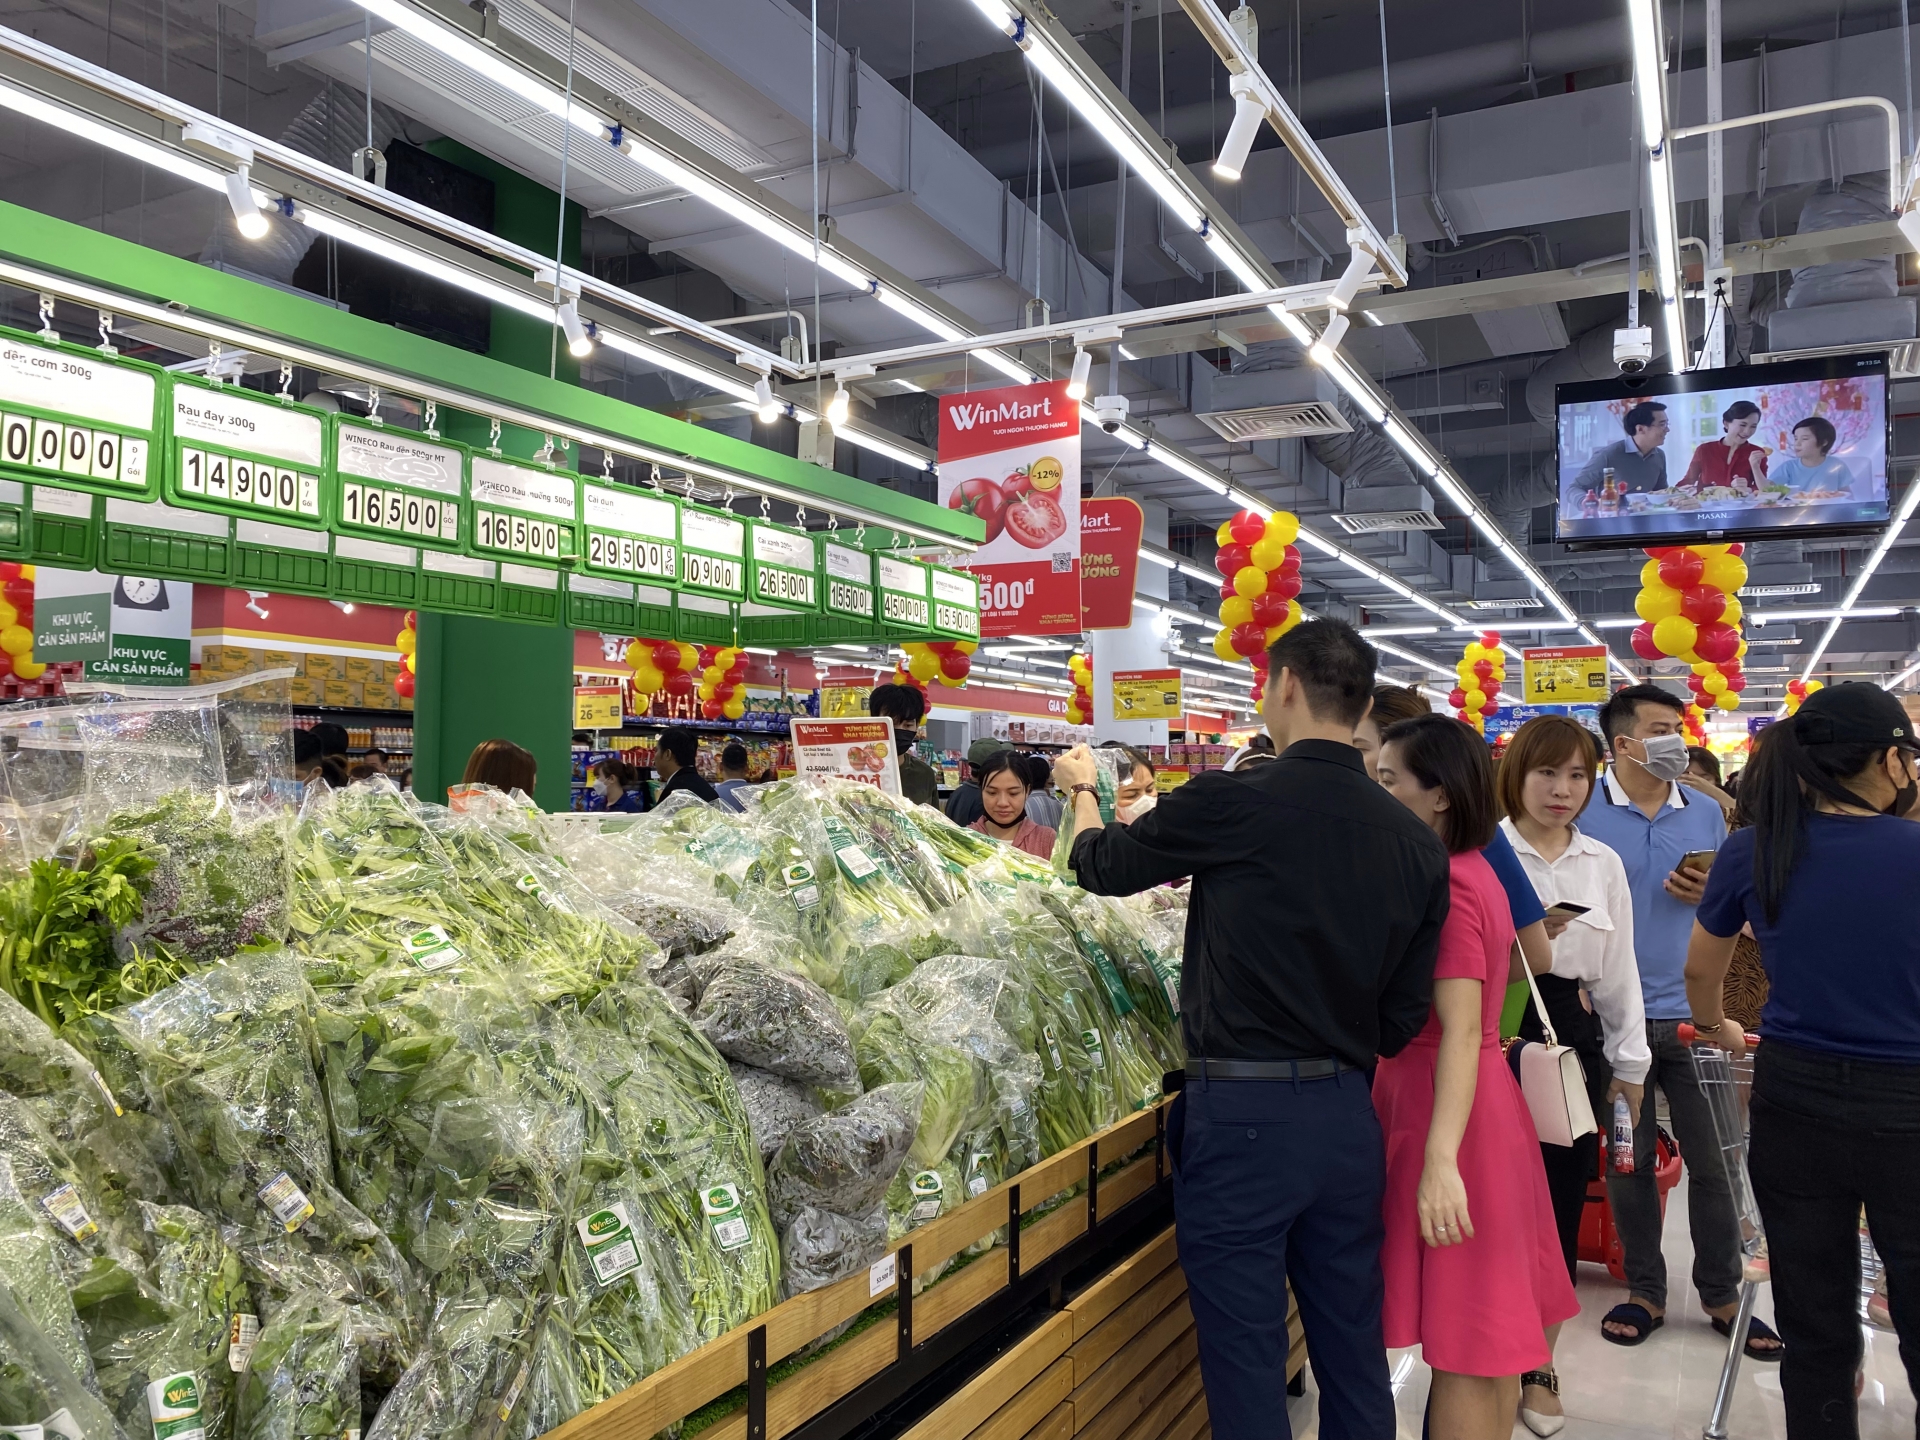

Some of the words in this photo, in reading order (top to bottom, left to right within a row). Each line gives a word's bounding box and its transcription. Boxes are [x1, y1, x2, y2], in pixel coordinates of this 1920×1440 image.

[31, 357, 58, 371] cơm
[62, 363, 92, 380] 300g
[178, 403, 200, 417] Rau
[204, 410, 225, 425] đay
[228, 415, 256, 432] 300g
[949, 397, 1052, 431] WinMart
[345, 433, 378, 448] WINECO
[380, 441, 395, 452] Rau
[434, 454, 446, 463] MT
[127, 467, 140, 476] Gói
[188, 453, 294, 506] 14.900
[1032, 468, 1059, 480] -12%
[479, 479, 510, 493] WINECO
[512, 486, 526, 496] Rau
[554, 495, 574, 507] 500gr
[347, 489, 436, 529] 16.500
[1697, 512, 1727, 520] MASAN
[481, 517, 556, 550] 16.500
[591, 536, 658, 569] 29.500
[1081, 553, 1113, 566] ỪNG
[759, 571, 805, 597] 26.500
[52, 613, 71, 626] KHU
[73, 611, 93, 628] VỰC
[38, 631, 58, 646] CÂN
[58, 628, 77, 645] SẢN
[79, 625, 105, 644] PHẨM
[113, 648, 138, 658] KHU
[141, 649, 167, 662] VỰC
[92, 661, 119, 673] CÂN
[122, 661, 148, 675] SẢN
[150, 662, 183, 677] PHẨM
[1534, 678, 1556, 693] 14
[580, 709, 593, 720] 26
[1049, 699, 1061, 713] GIA
[800, 725, 828, 734] WinMart
[590, 1216, 617, 1232] WinEco
